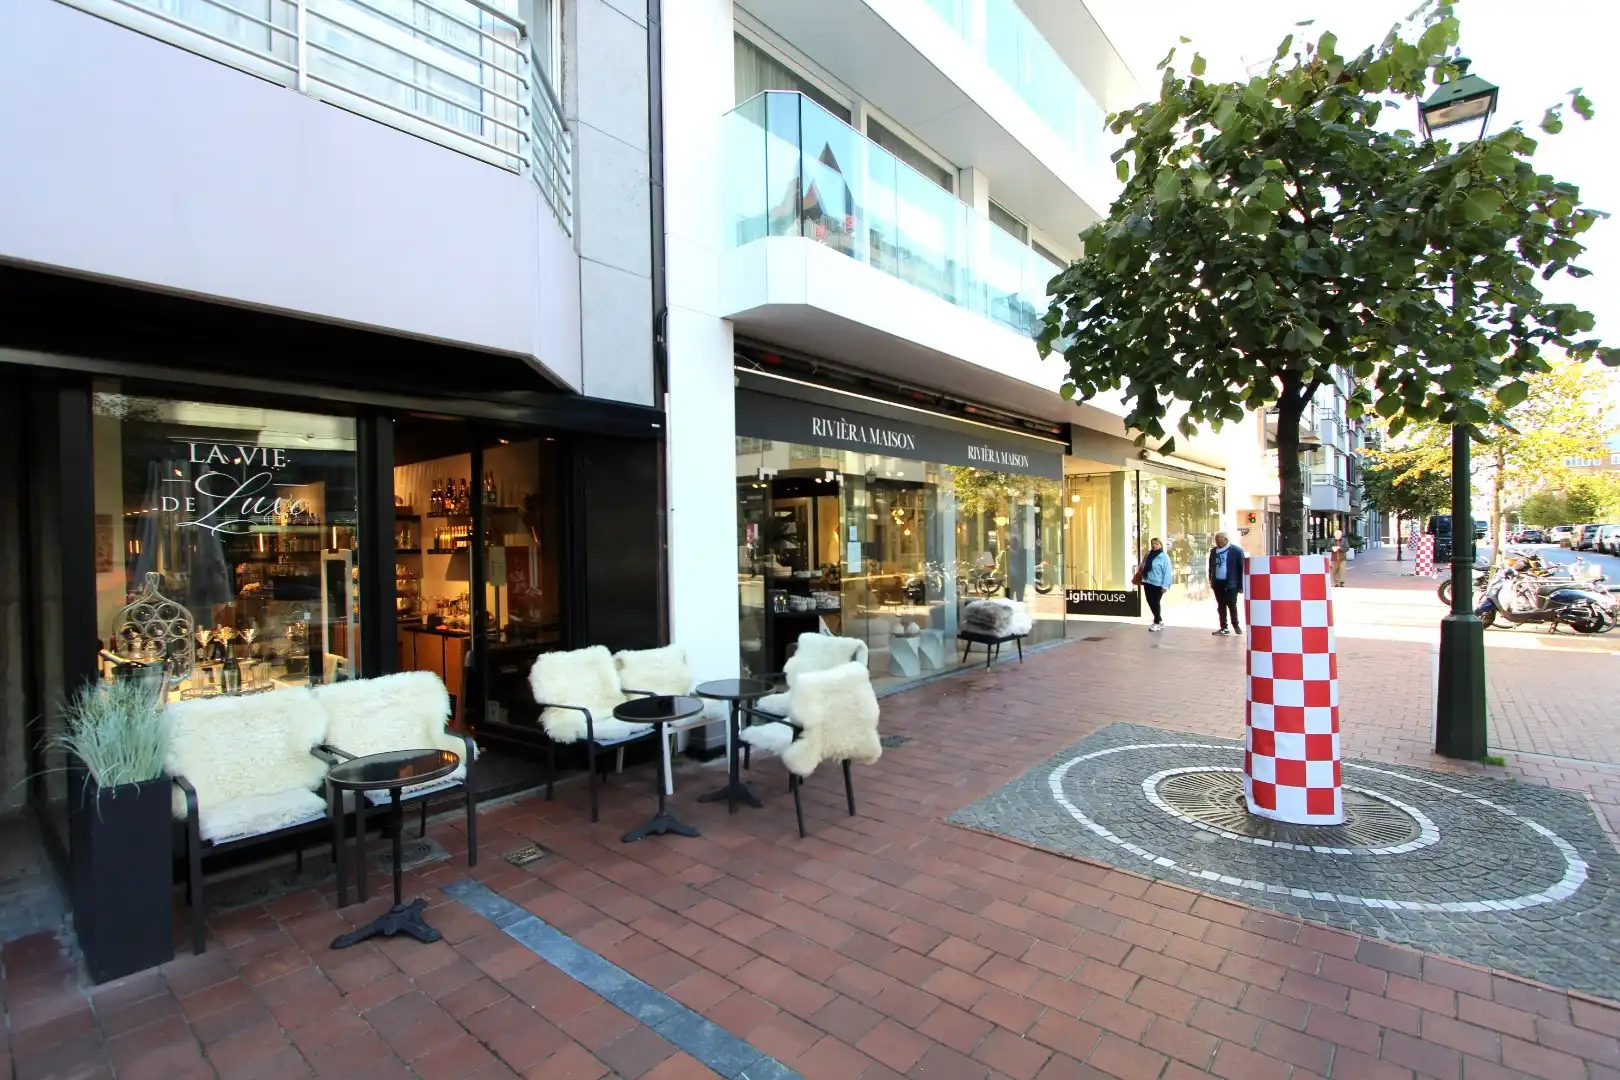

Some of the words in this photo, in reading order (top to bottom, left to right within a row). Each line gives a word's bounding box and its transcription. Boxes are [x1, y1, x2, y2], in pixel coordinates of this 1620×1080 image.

[811, 416, 867, 444] RIVIÈRA
[868, 429, 916, 450] MAISON
[189, 442, 229, 464] LA
[238, 446, 286, 468] VIE
[967, 444, 1000, 464] RIVIÈRA
[1001, 452, 1029, 468] MAISON
[161, 495, 196, 513] DE
